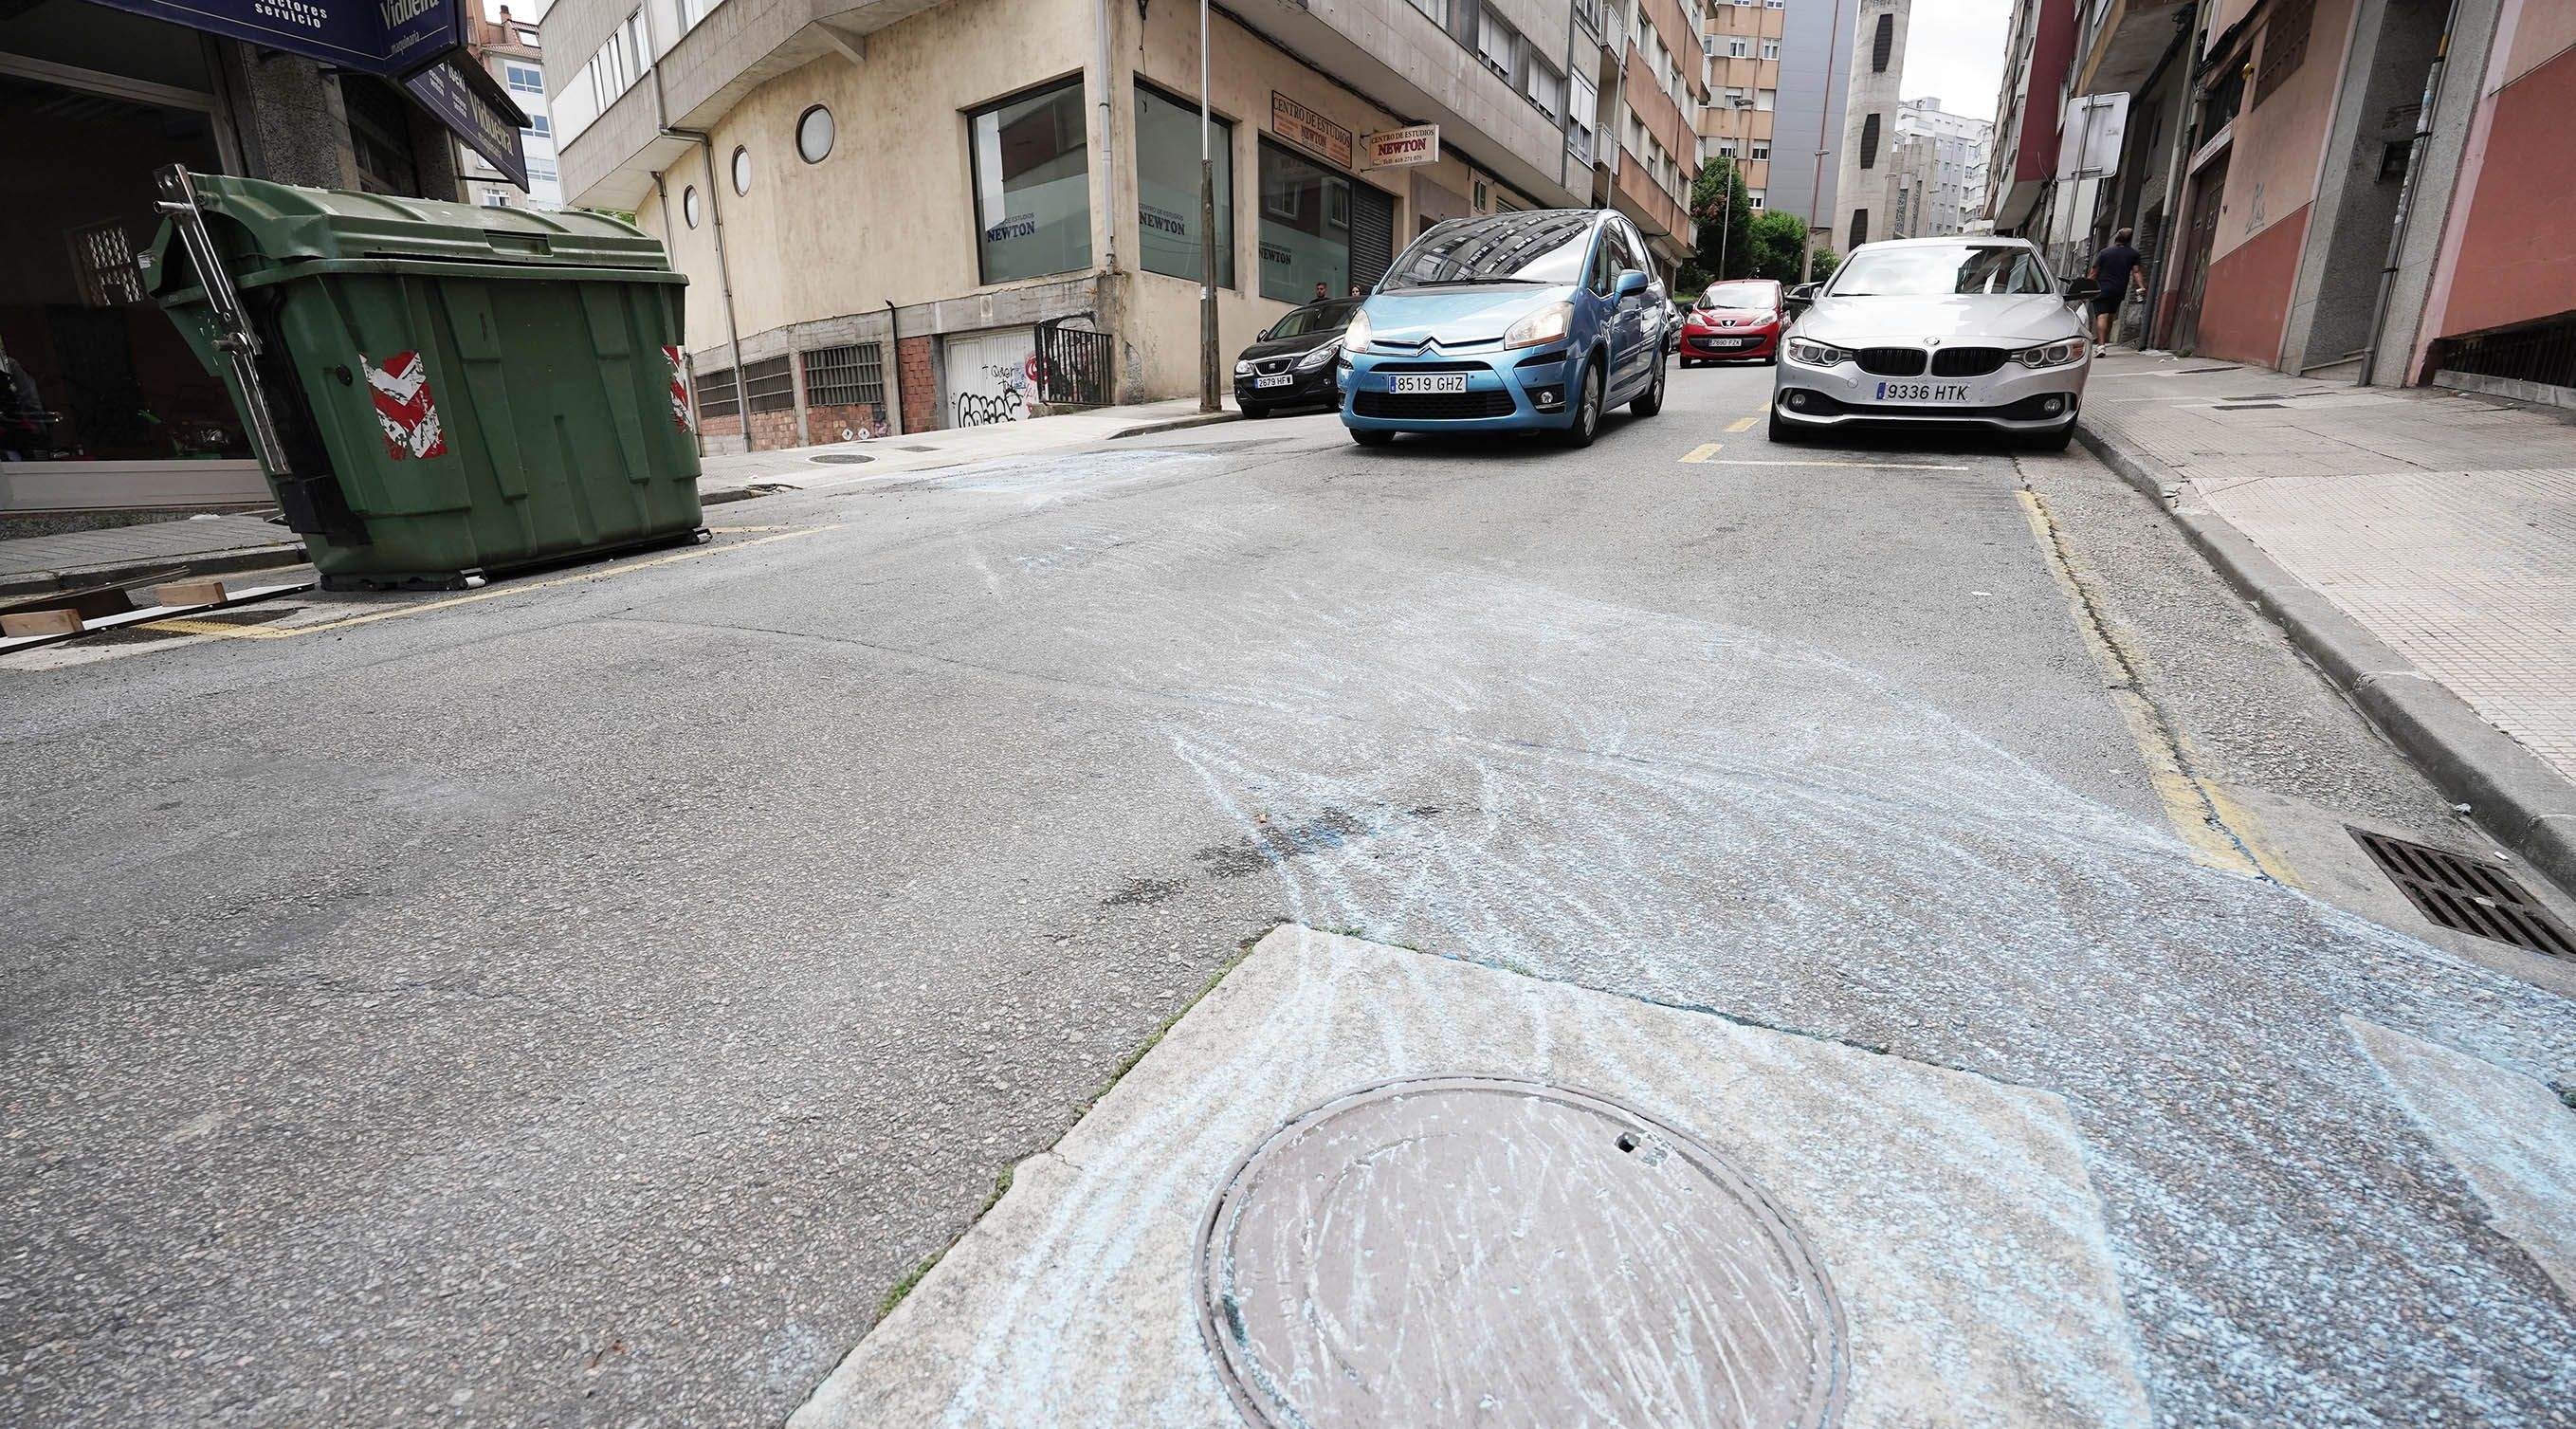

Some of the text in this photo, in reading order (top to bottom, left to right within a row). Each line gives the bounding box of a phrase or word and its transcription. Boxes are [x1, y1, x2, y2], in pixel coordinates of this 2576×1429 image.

[254, 3, 320, 28] servicio
[261, 0, 327, 18] actores
[468, 87, 514, 156] Vidueira
[1273, 97, 1305, 121] CENTRO
[1306, 111, 1316, 128] DE
[1317, 119, 1350, 148] ESTUDIOS
[1301, 124, 1327, 147] NEWTON
[1372, 134, 1396, 144] CENTRO
[1404, 129, 1434, 138] ESTUDIOS
[1378, 137, 1427, 156] NEWTON
[987, 221, 1035, 243] NEWTON
[1139, 211, 1185, 235] NEWTON
[1259, 247, 1291, 265] NEWTON
[1258, 377, 1275, 387] 2679
[1398, 376, 1463, 392] 8519 GHZ
[1888, 384, 1968, 400] 9336 HTK
